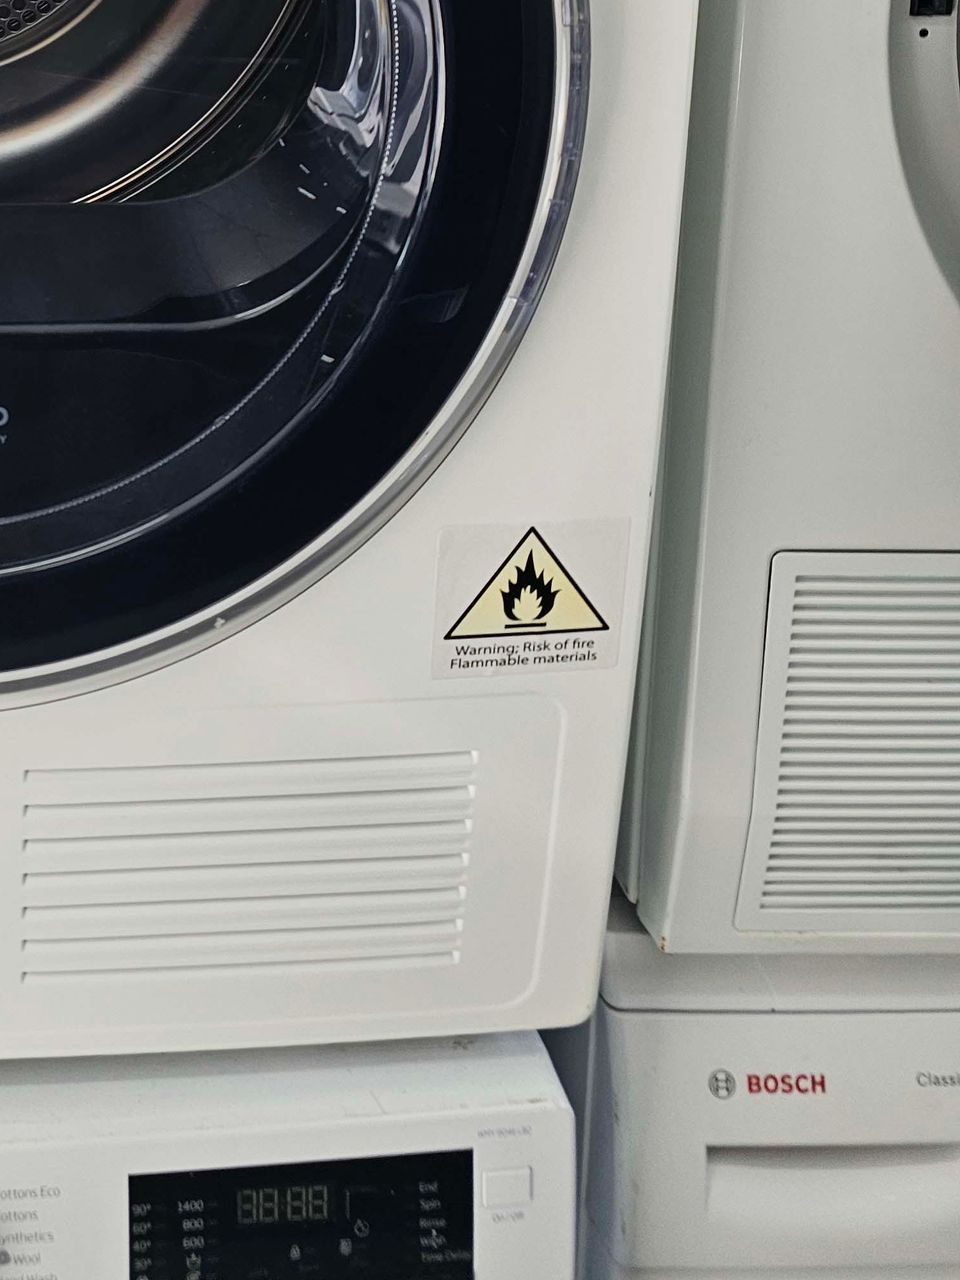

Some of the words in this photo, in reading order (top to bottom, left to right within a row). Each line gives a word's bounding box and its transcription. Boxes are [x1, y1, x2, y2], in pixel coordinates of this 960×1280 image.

[523, 640, 551, 653] Risk
[554, 638, 569, 651] of
[572, 637, 595, 650] fire
[450, 654, 530, 670] Flammable
[533, 650, 598, 665] materials
[746, 1073, 827, 1094] BOSCH
[40, 1184, 61, 1197] Eco
[177, 1199, 204, 1214] 1400
[182, 1218, 204, 1231] 800
[182, 1236, 205, 1250] 600
[13, 1252, 41, 1266] Wool
